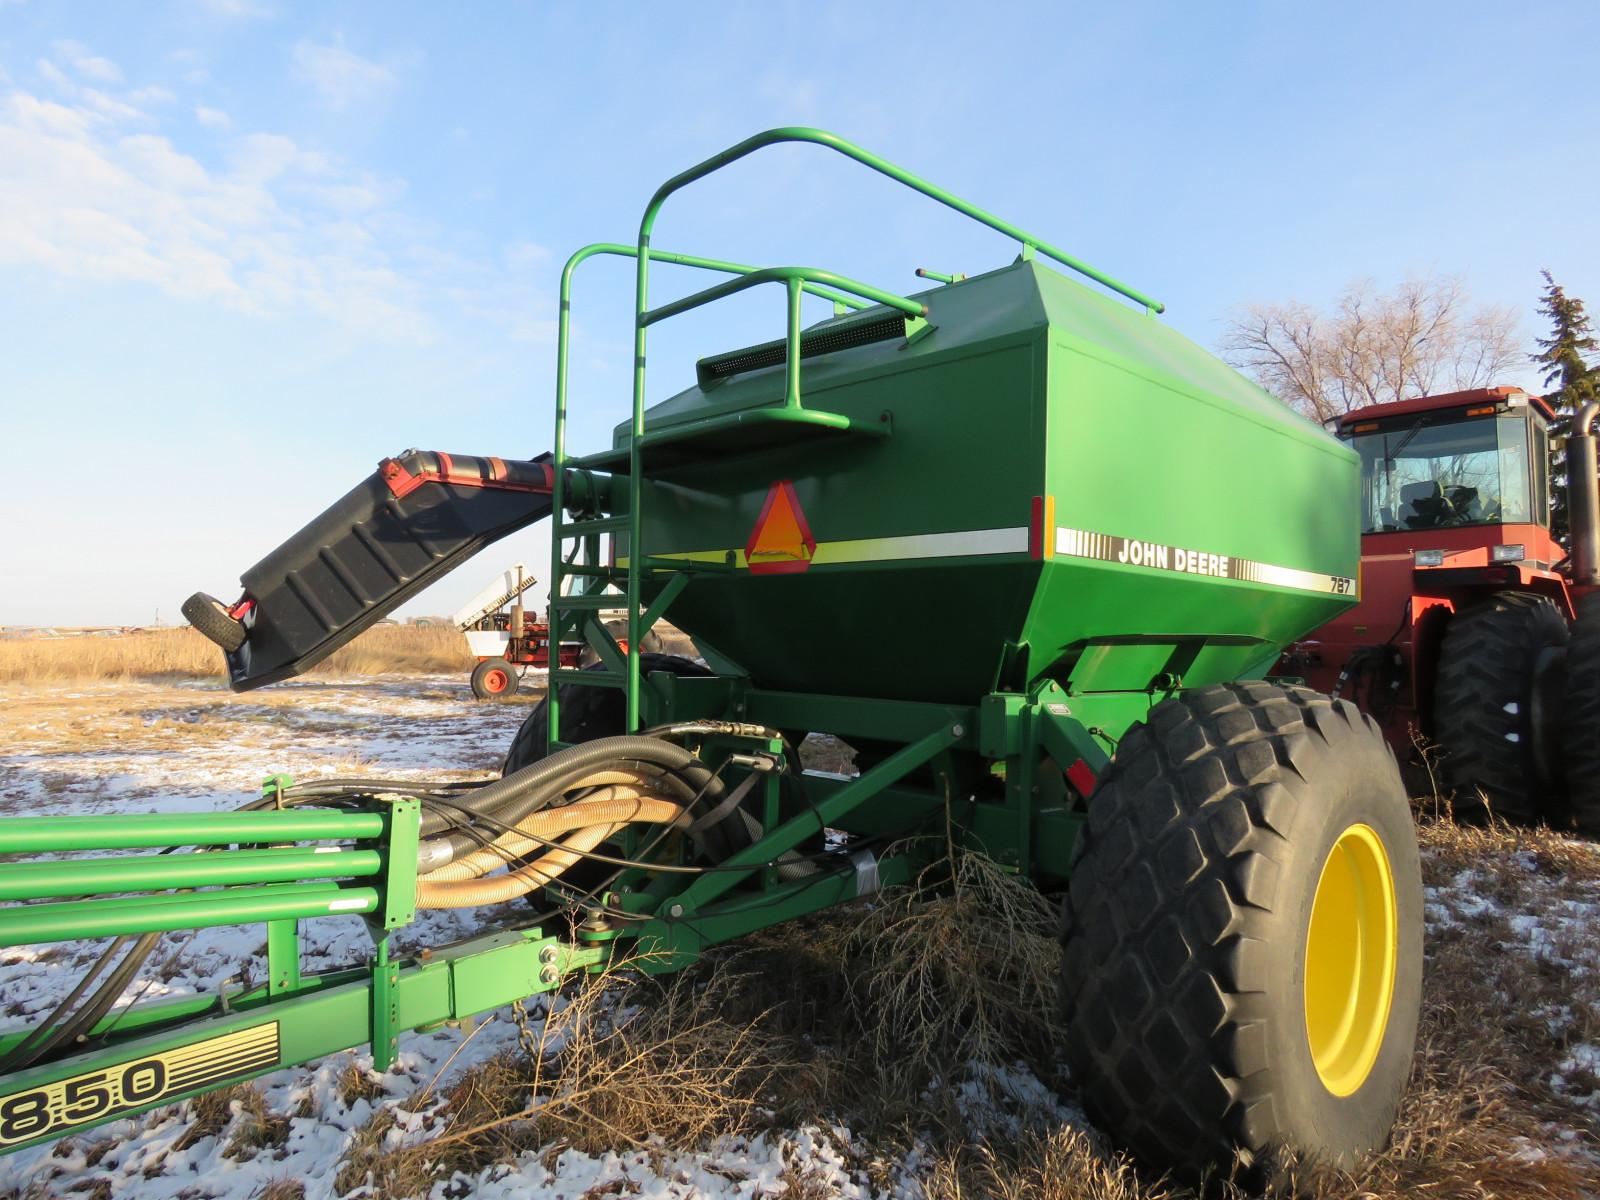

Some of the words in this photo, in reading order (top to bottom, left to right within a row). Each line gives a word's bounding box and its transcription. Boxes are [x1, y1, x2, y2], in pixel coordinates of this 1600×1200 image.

[1118, 538, 1168, 569] JOHN
[1174, 548, 1229, 578] DEERE
[1331, 576, 1350, 594] 787
[0, 1059, 167, 1141] 850
